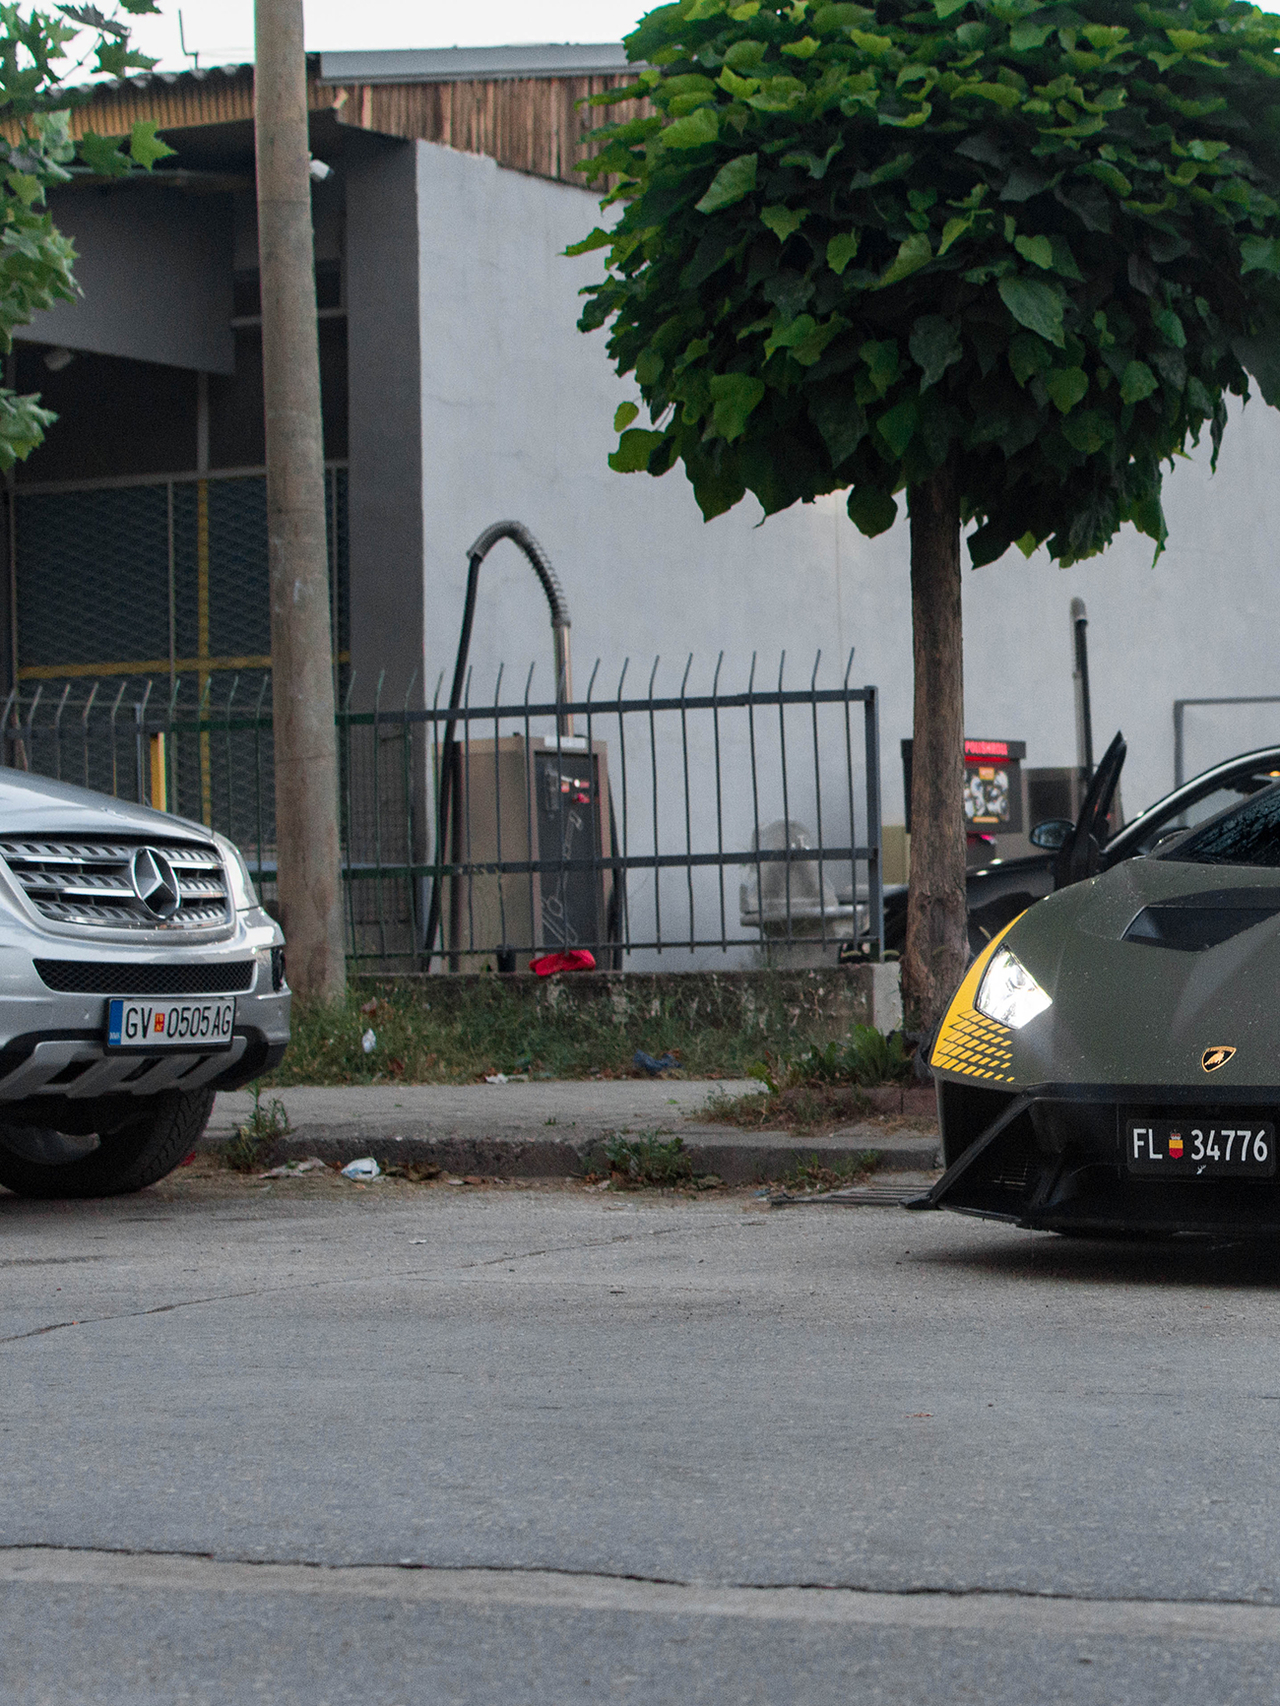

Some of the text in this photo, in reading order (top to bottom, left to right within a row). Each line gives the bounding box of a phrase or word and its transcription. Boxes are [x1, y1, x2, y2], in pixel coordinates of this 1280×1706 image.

[126, 1007, 152, 1038] GV
[1133, 1128, 1268, 1162] FL 34776
